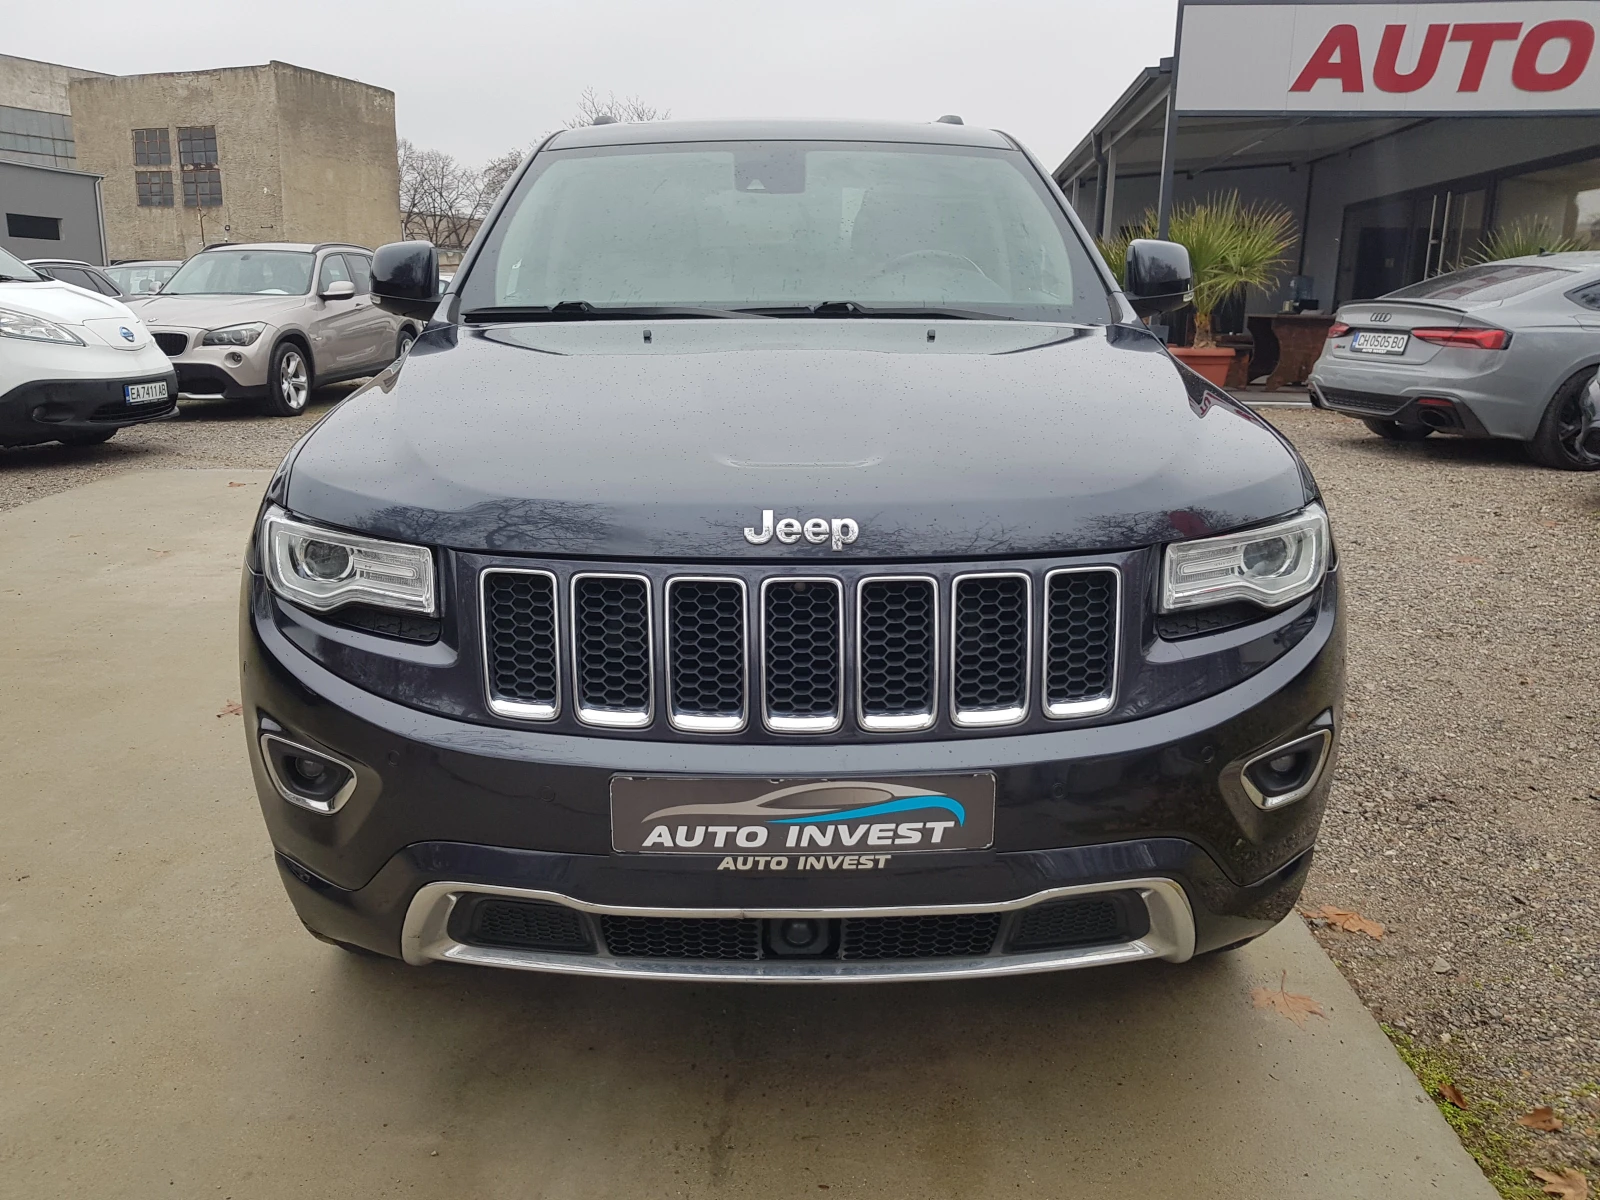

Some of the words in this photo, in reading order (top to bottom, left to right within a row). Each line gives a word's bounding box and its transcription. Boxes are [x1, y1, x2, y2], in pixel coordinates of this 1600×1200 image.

[1287, 19, 1595, 93] AUTO
[743, 509, 860, 552] Jeep
[642, 824, 768, 848] AUTO
[786, 821, 955, 848] INVEST
[717, 856, 789, 871] AUTO
[797, 855, 892, 870] INVEST
